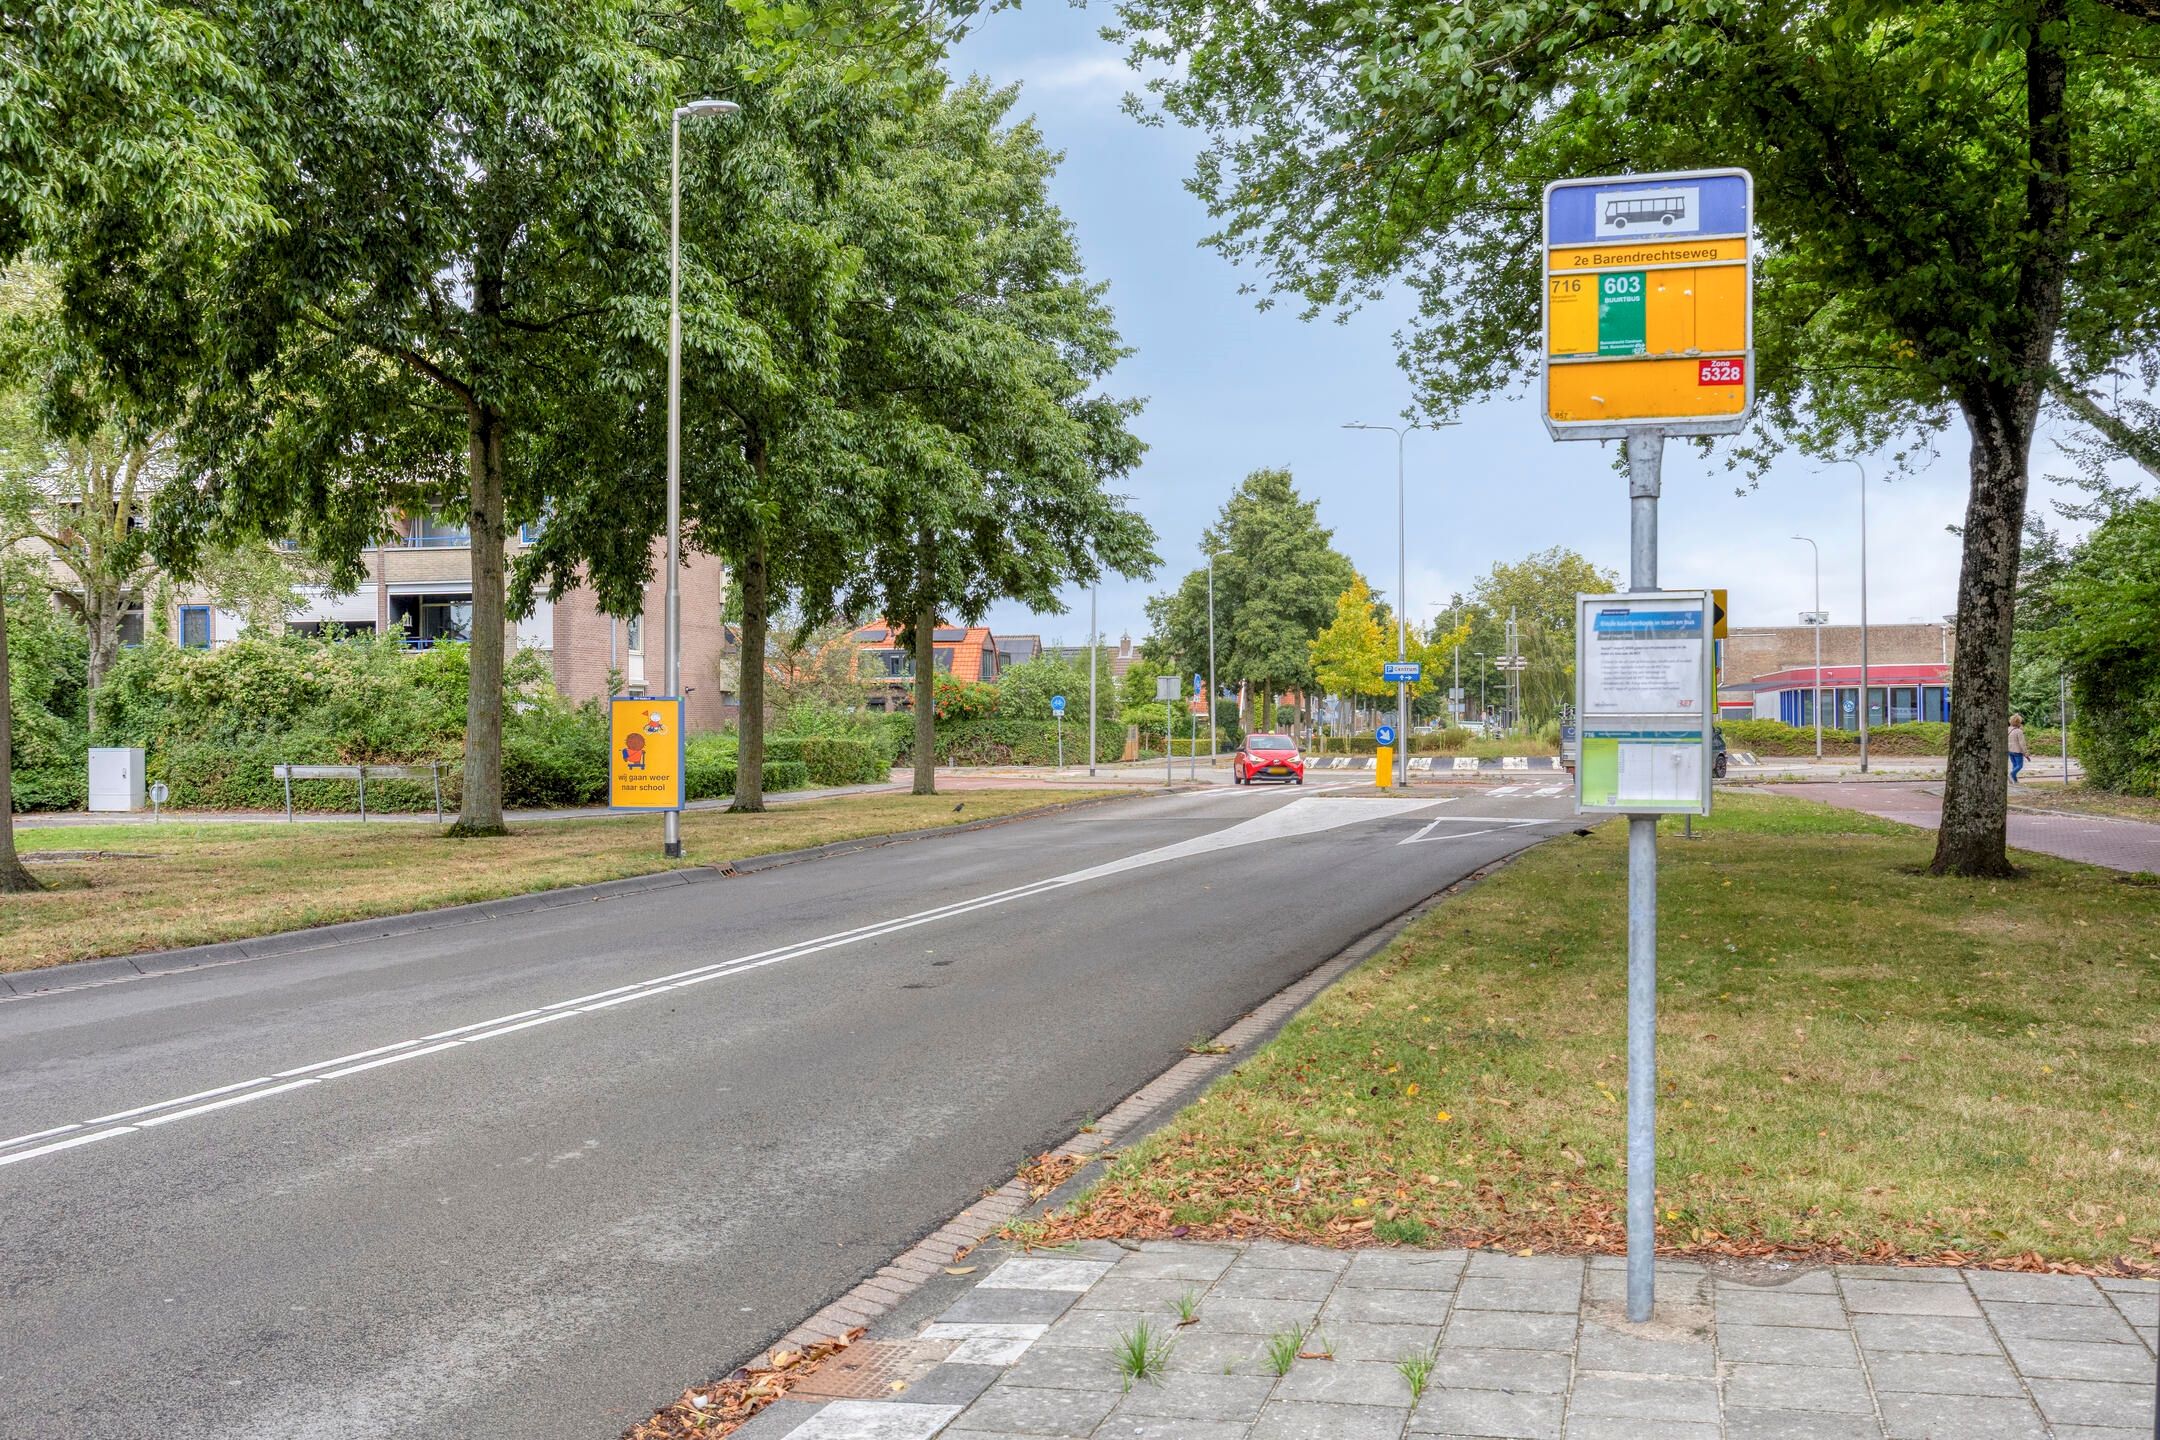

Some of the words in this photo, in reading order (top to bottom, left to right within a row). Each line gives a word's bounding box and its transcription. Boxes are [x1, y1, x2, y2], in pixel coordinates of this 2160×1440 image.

[1574, 255, 1589, 266] 2e
[1593, 248, 1718, 265] Barendrechtseweg
[1551, 279, 1581, 294] 716
[1604, 276, 1641, 294] 603
[1604, 295, 1641, 304] BUURTBUS
[1701, 367, 1740, 382] 5328
[618, 774, 628, 782] wij
[629, 775, 647, 783] gaan
[639, 783, 666, 791] school
